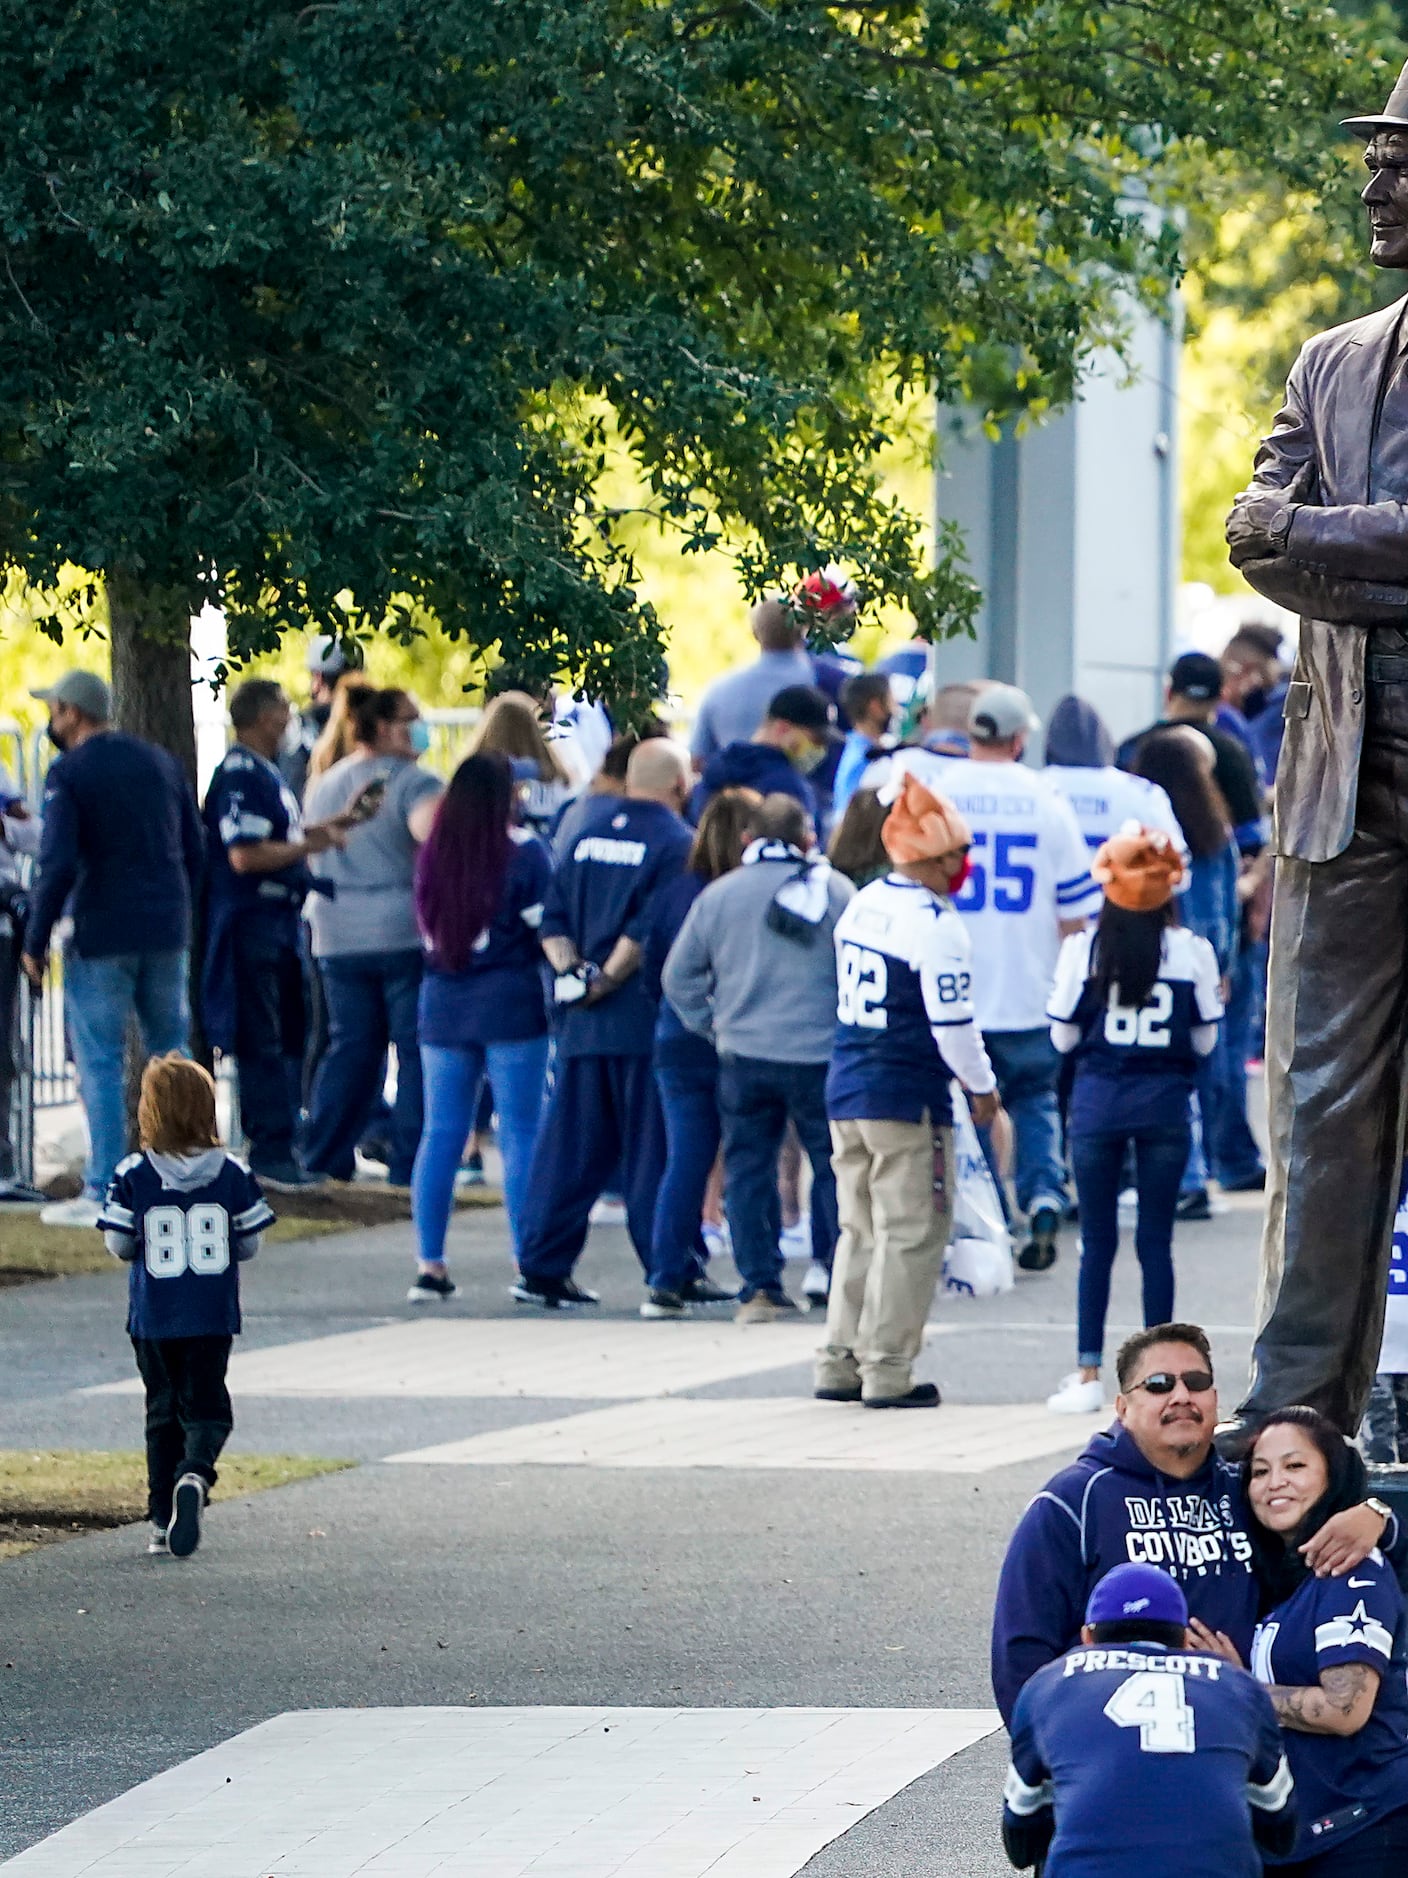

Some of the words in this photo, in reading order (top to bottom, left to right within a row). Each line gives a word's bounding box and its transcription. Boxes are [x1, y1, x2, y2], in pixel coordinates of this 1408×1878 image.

[837, 942, 889, 1030] 82
[143, 1202, 231, 1279] 88
[1062, 1650, 1222, 1681] PRESCOTT
[1103, 1672, 1196, 1754] 4
